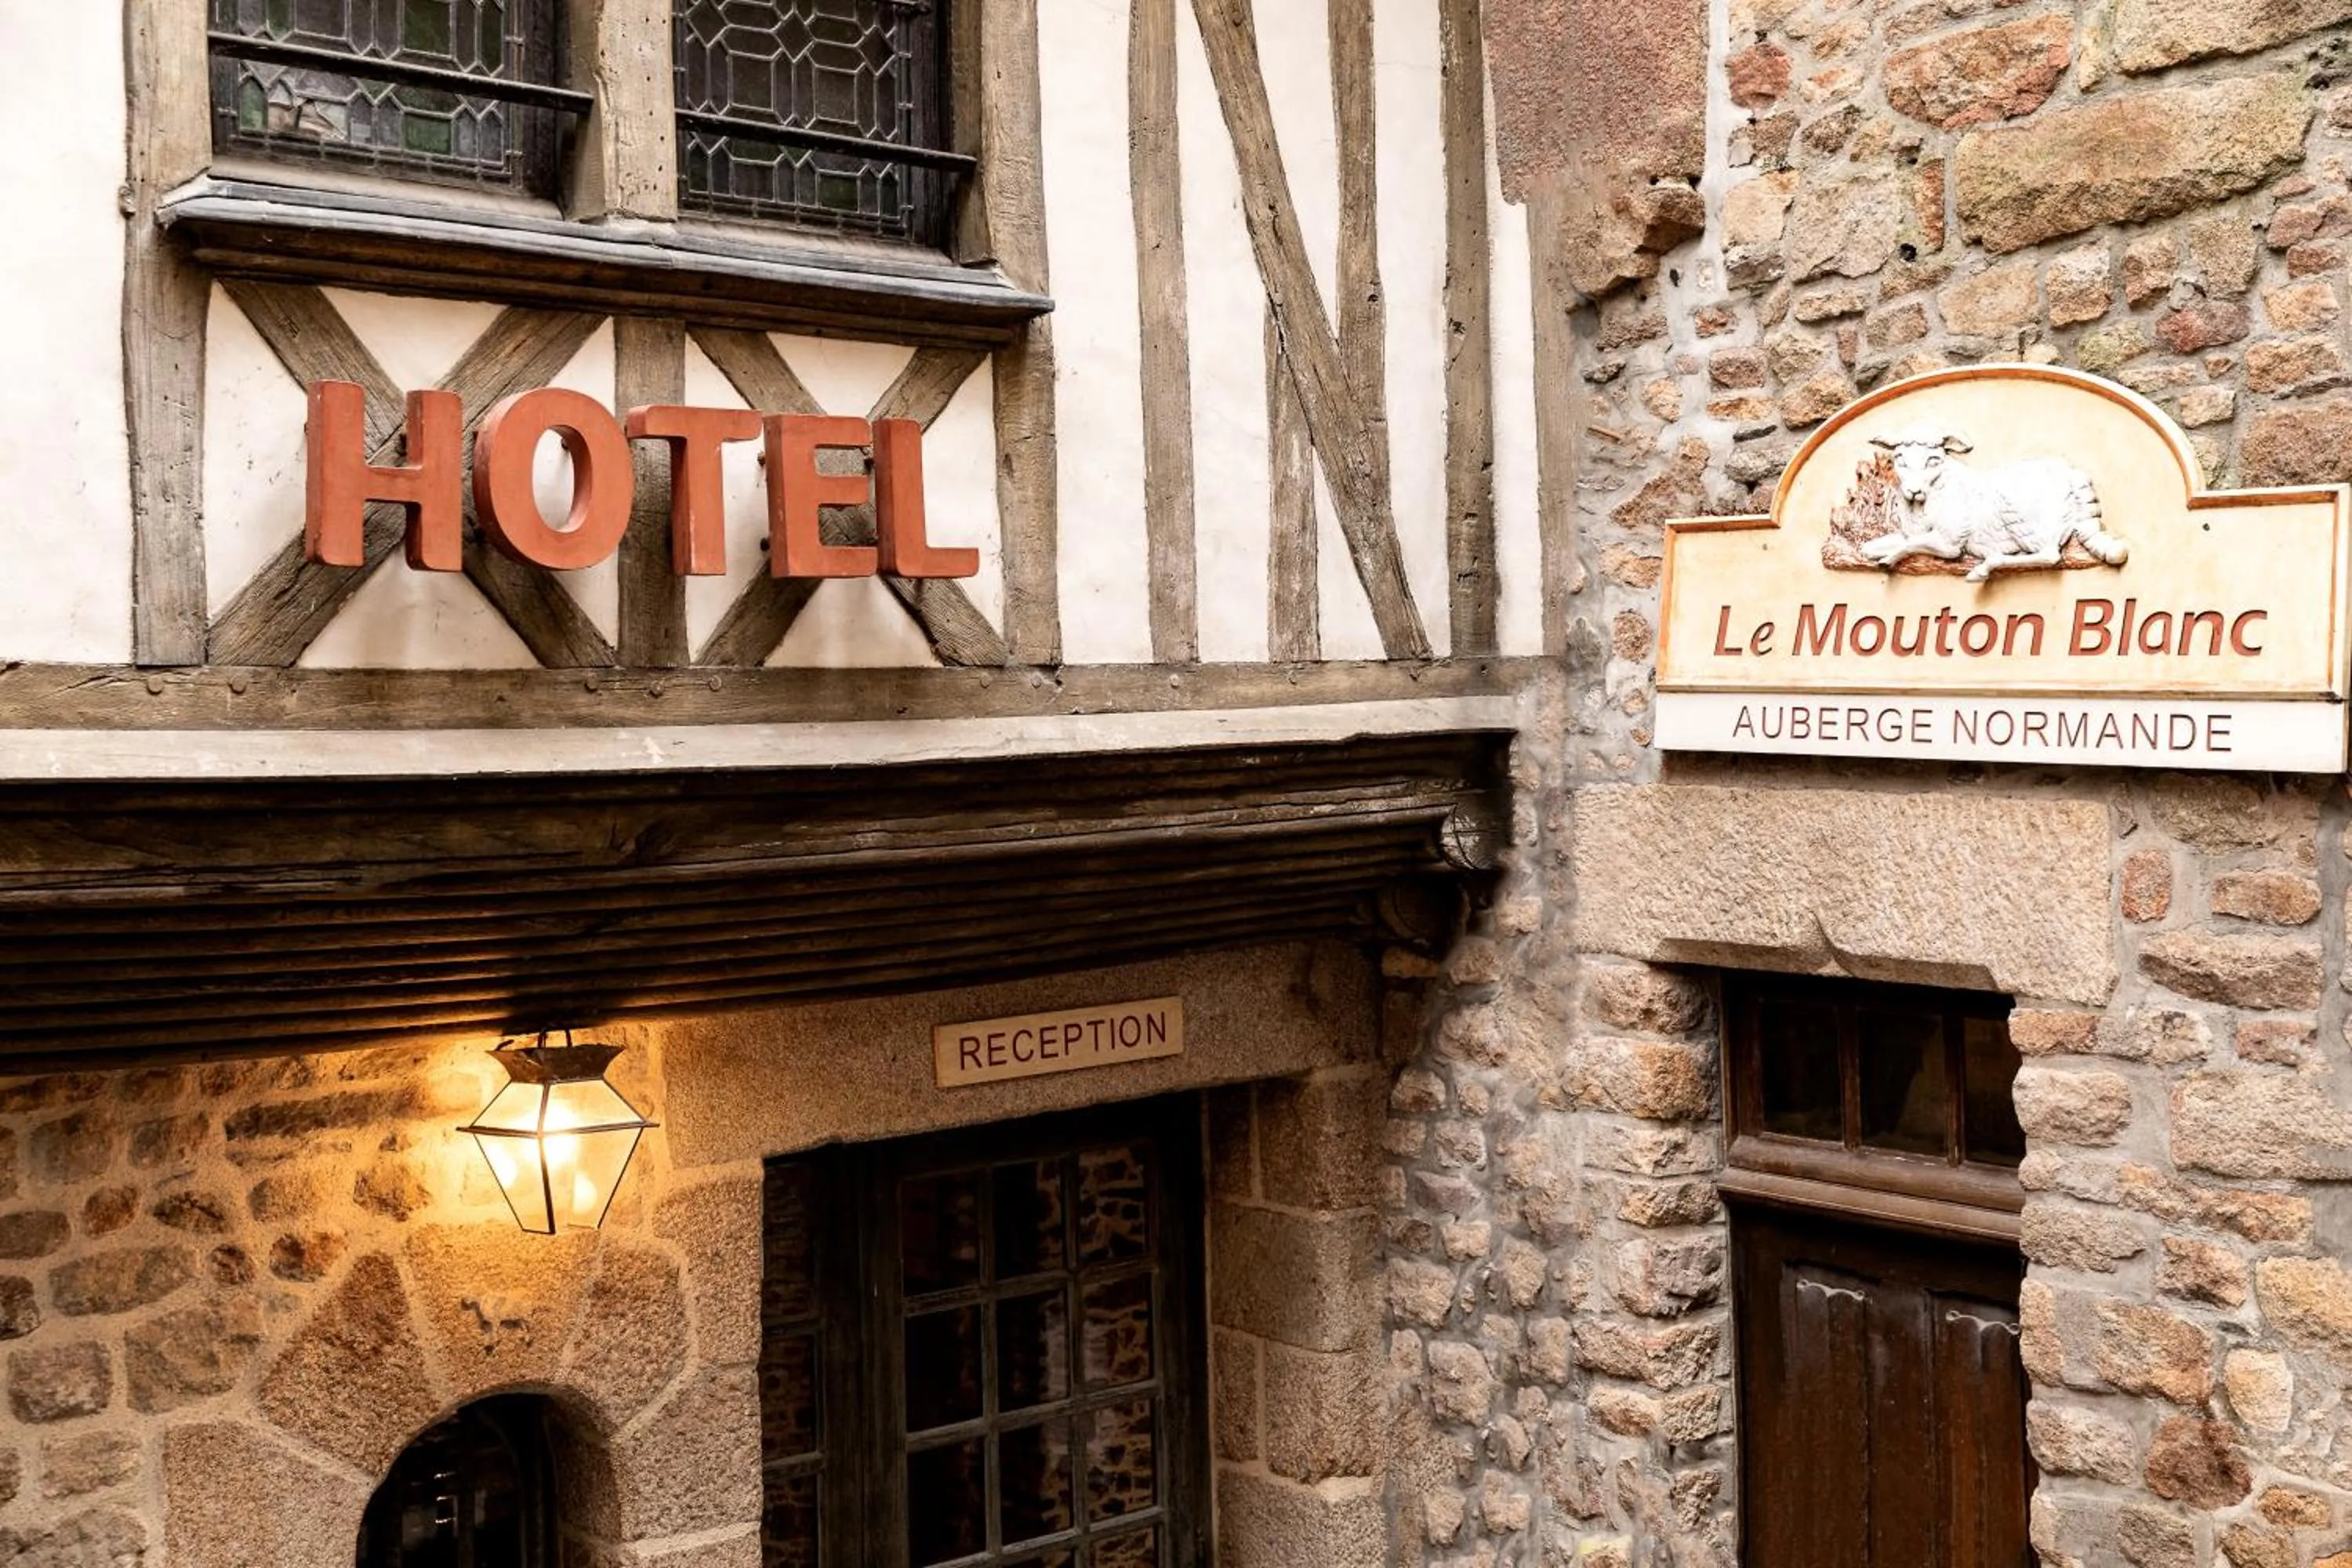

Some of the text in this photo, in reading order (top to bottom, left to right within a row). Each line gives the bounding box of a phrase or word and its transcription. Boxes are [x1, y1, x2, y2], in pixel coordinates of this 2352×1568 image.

[306, 379, 980, 579] HOTEL
[1713, 597, 2268, 657] Le Mouton Blanc
[1732, 704, 2234, 753] AUBERGE NORMANDE
[958, 1011, 1166, 1071] RECEPTION
